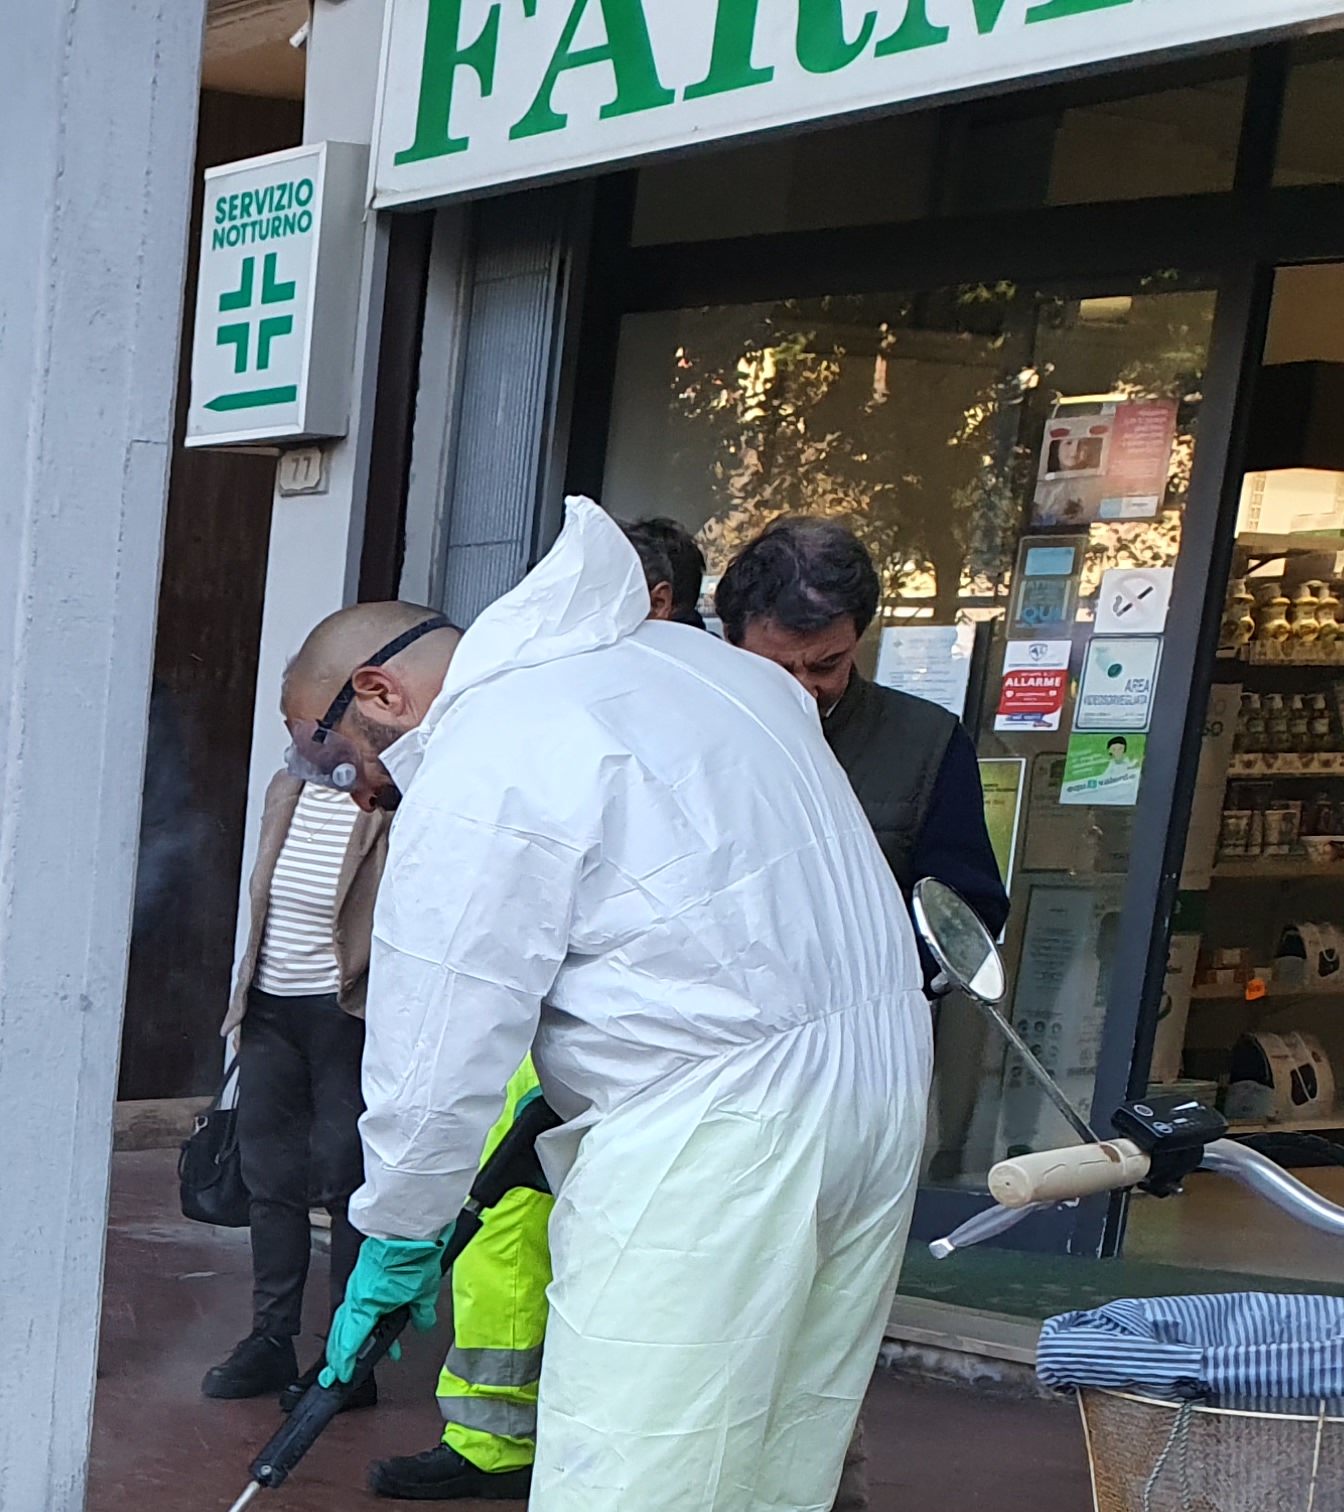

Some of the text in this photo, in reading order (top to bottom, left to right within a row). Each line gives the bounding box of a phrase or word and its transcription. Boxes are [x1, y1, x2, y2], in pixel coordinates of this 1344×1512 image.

[215, 178, 314, 225] SERVIZIO
[212, 209, 313, 251] NOTTURNO
[291, 455, 313, 482] 77
[1004, 676, 1062, 688] ALLARME
